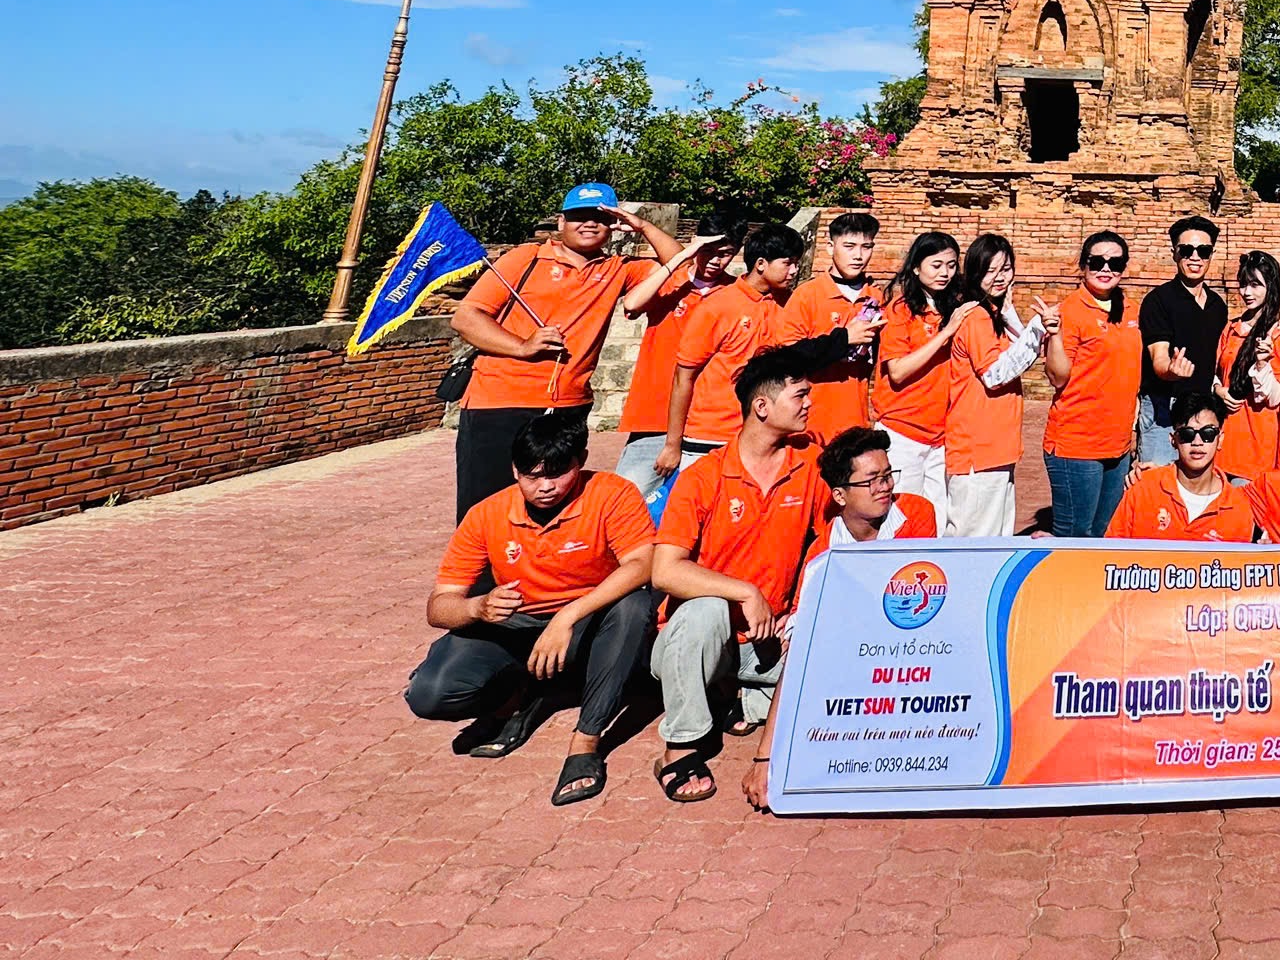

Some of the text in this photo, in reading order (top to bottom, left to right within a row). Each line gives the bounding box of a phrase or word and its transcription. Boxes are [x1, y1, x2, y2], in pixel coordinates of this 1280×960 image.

[413, 240, 446, 271] TOURIST
[1105, 564, 1161, 592] Trường
[1165, 564, 1196, 589] Cao
[1200, 559, 1242, 590] Đẳng
[1244, 564, 1275, 587] FPT
[1186, 604, 1227, 637] Lớp:
[859, 638, 953, 658] Đơn vị tổ chức
[872, 667, 931, 686] DU LỊCH
[1053, 674, 1118, 714] Tham
[1126, 678, 1182, 717] quan
[1189, 671, 1240, 718] thực
[1247, 662, 1272, 709] tế
[825, 695, 971, 716] VIETSUN TOURIST
[842, 728, 861, 741] vui
[889, 726, 912, 742] mọi
[828, 756, 949, 774] Hotline: 0939.844.234
[1156, 741, 1200, 764] Thời
[1206, 740, 1256, 767] gian:
